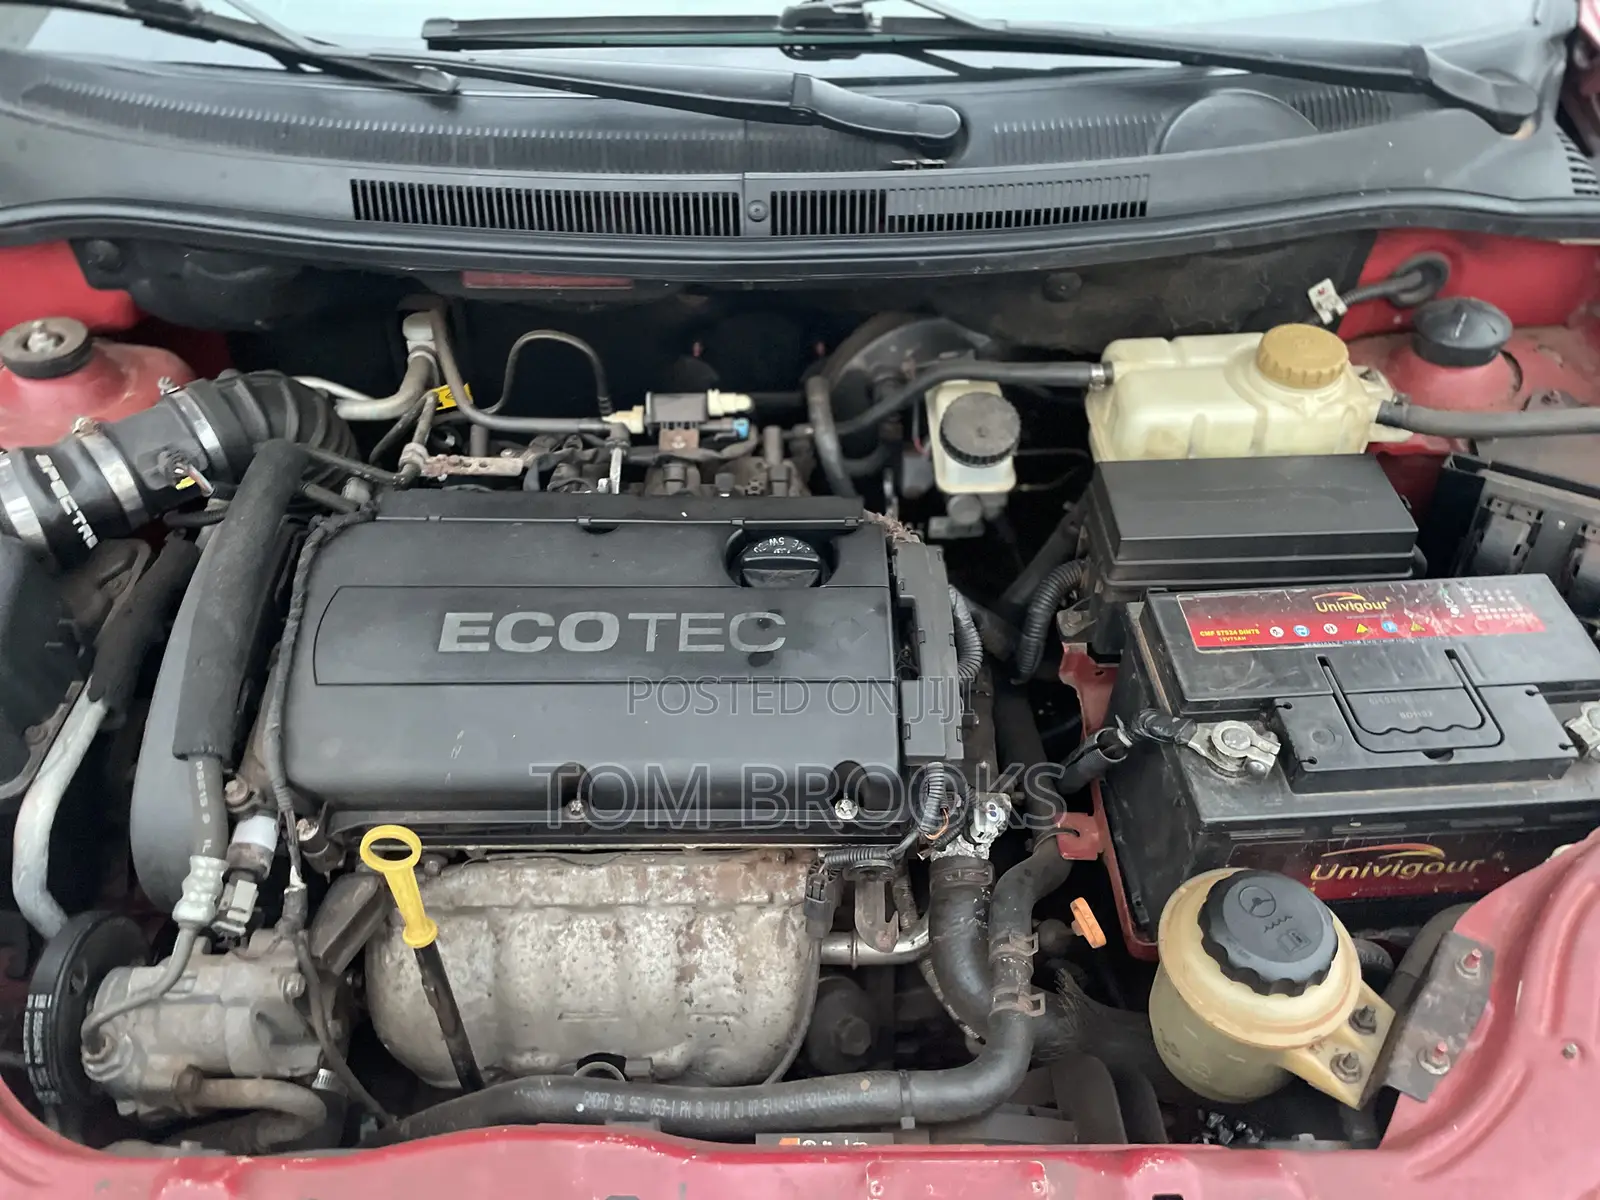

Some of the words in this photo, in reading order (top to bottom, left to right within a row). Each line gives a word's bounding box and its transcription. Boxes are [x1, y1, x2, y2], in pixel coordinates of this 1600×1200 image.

[1315, 600, 1388, 613] Univigour
[438, 610, 787, 655] ECOTEC
[1310, 859, 1486, 881] Univigour
